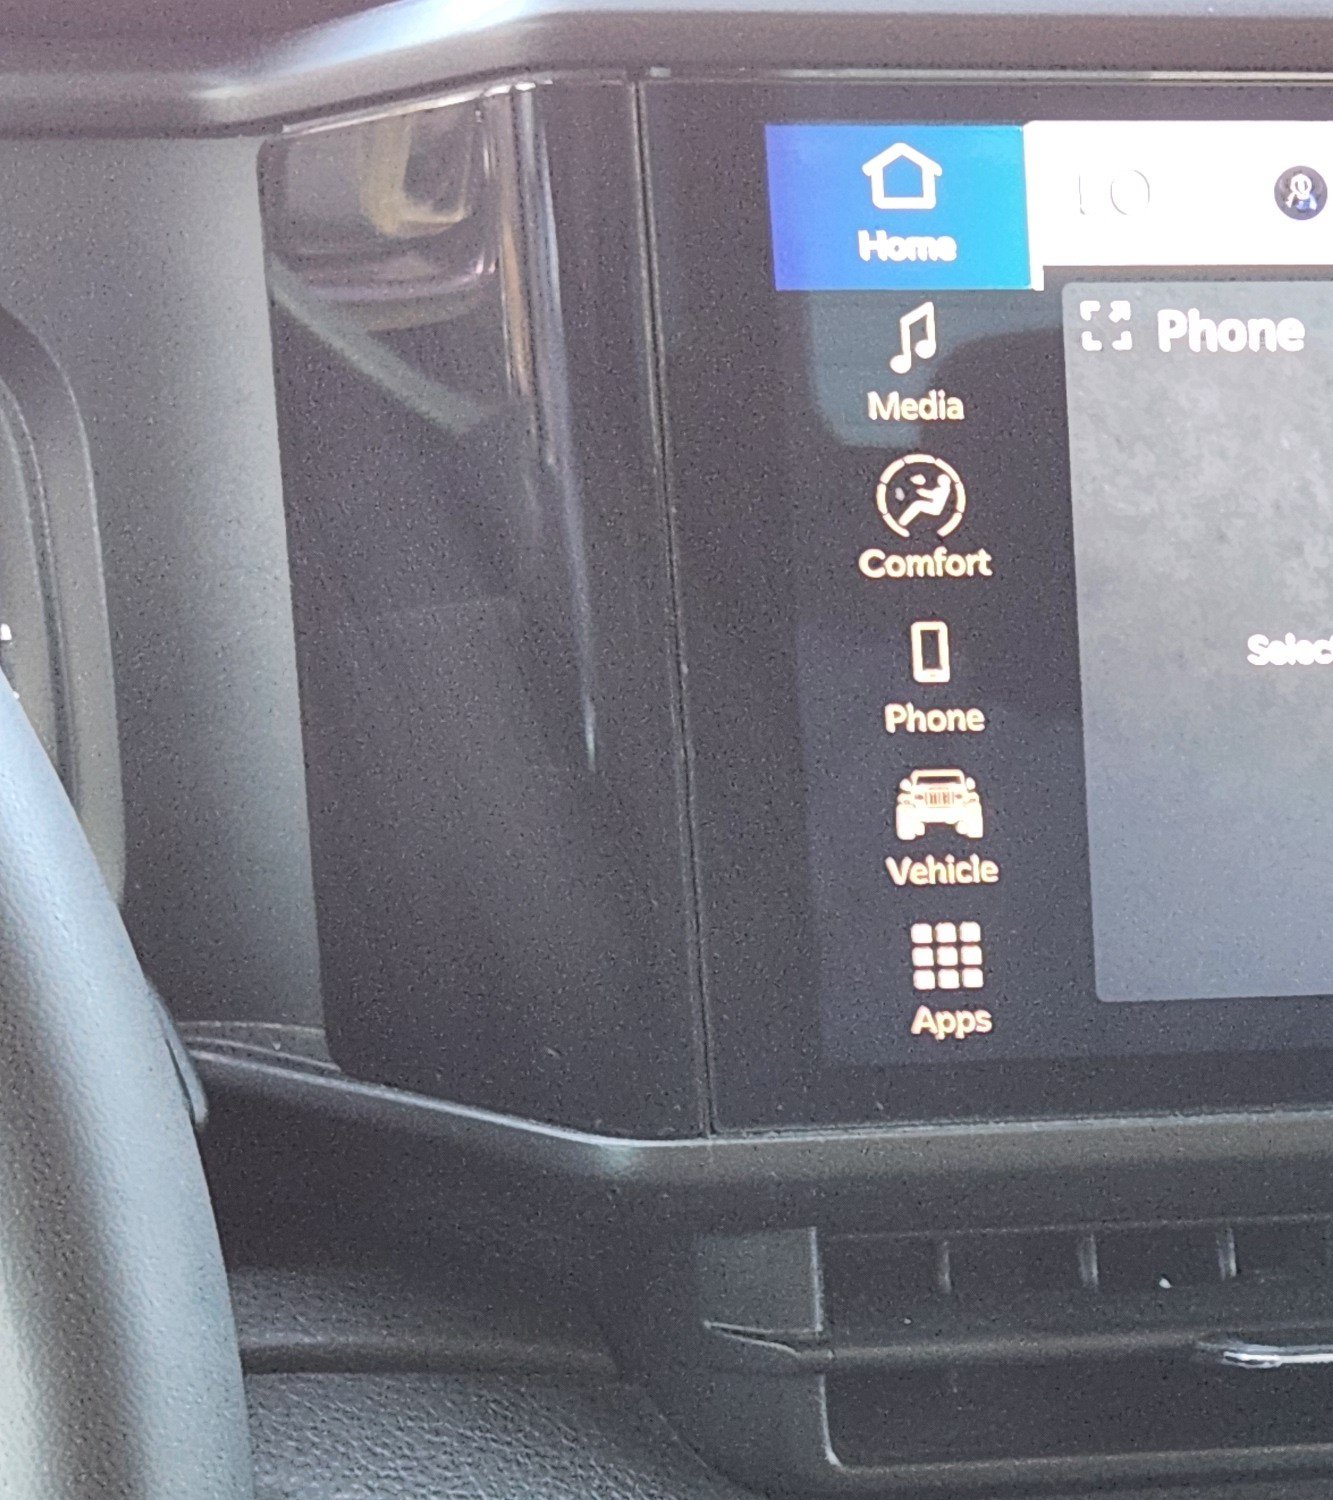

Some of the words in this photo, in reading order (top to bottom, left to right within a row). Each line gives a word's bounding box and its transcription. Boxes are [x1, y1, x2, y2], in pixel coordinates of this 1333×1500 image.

[857, 230, 957, 262] Home
[1156, 308, 1306, 353] Phone
[866, 391, 965, 421] Media
[858, 547, 993, 579] Comfort
[884, 702, 986, 733] Phone
[885, 853, 999, 886] Vehicle
[910, 1005, 993, 1039] Apps
